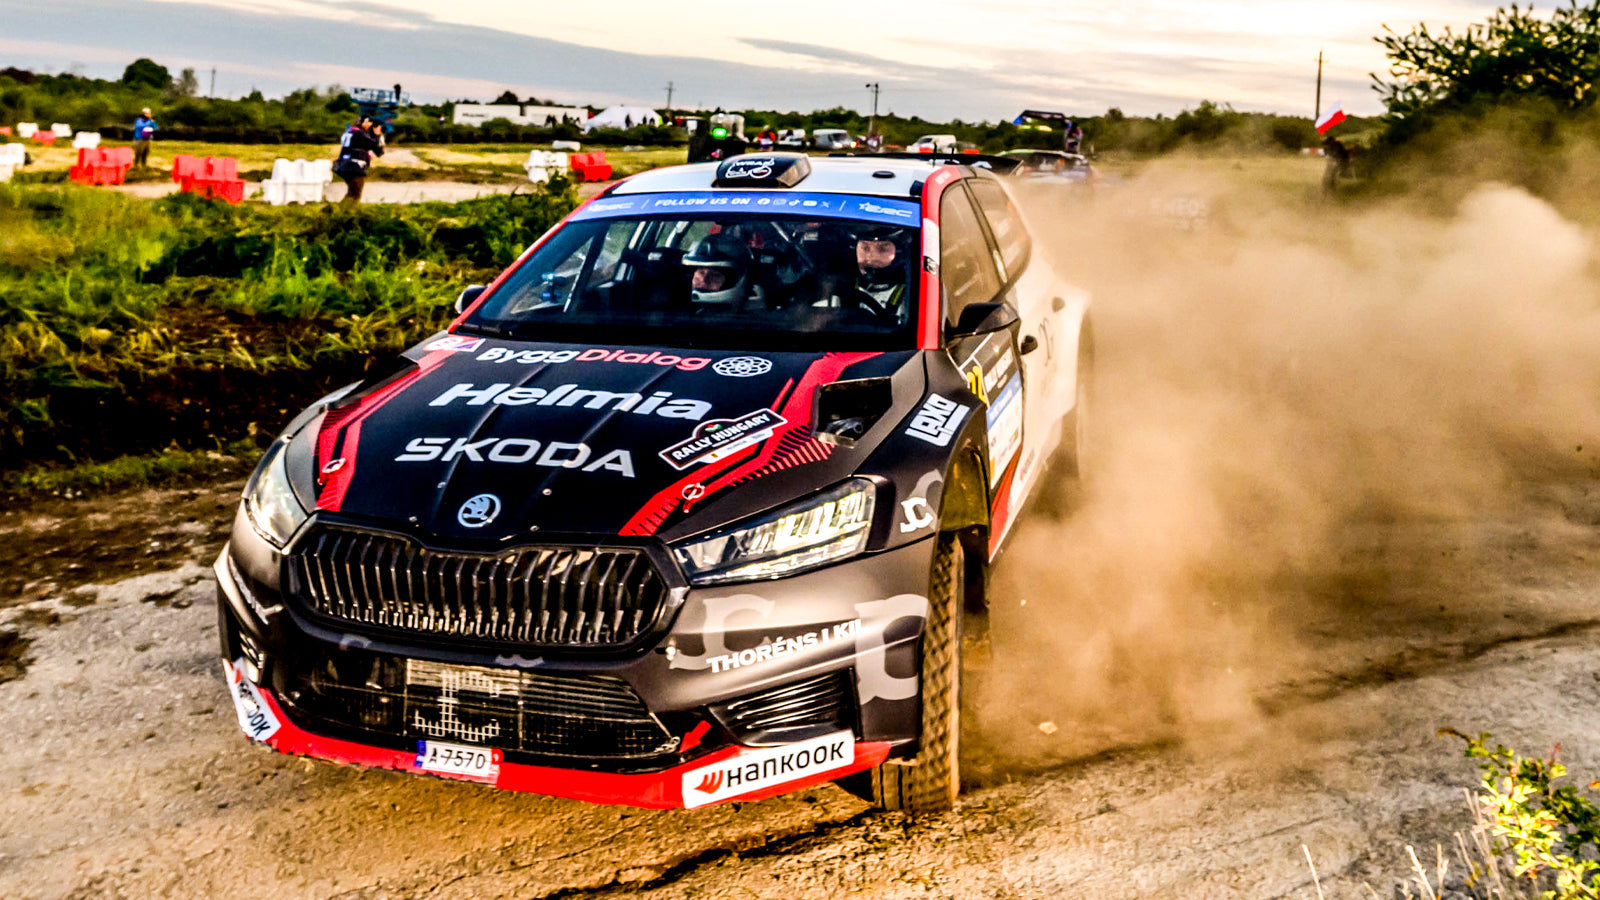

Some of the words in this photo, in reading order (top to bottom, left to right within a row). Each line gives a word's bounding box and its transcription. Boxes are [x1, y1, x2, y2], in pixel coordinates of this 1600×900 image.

[654, 198, 708, 207] FOLLOW
[709, 197, 727, 205] US
[475, 347, 712, 371] ByggDialog
[428, 383, 713, 421] Helmia
[671, 436, 713, 461] RALLY
[710, 413, 771, 442] HUNGARY
[394, 437, 636, 478] SKODA
[706, 632, 818, 673] THORÉNS
[821, 628, 830, 645] I
